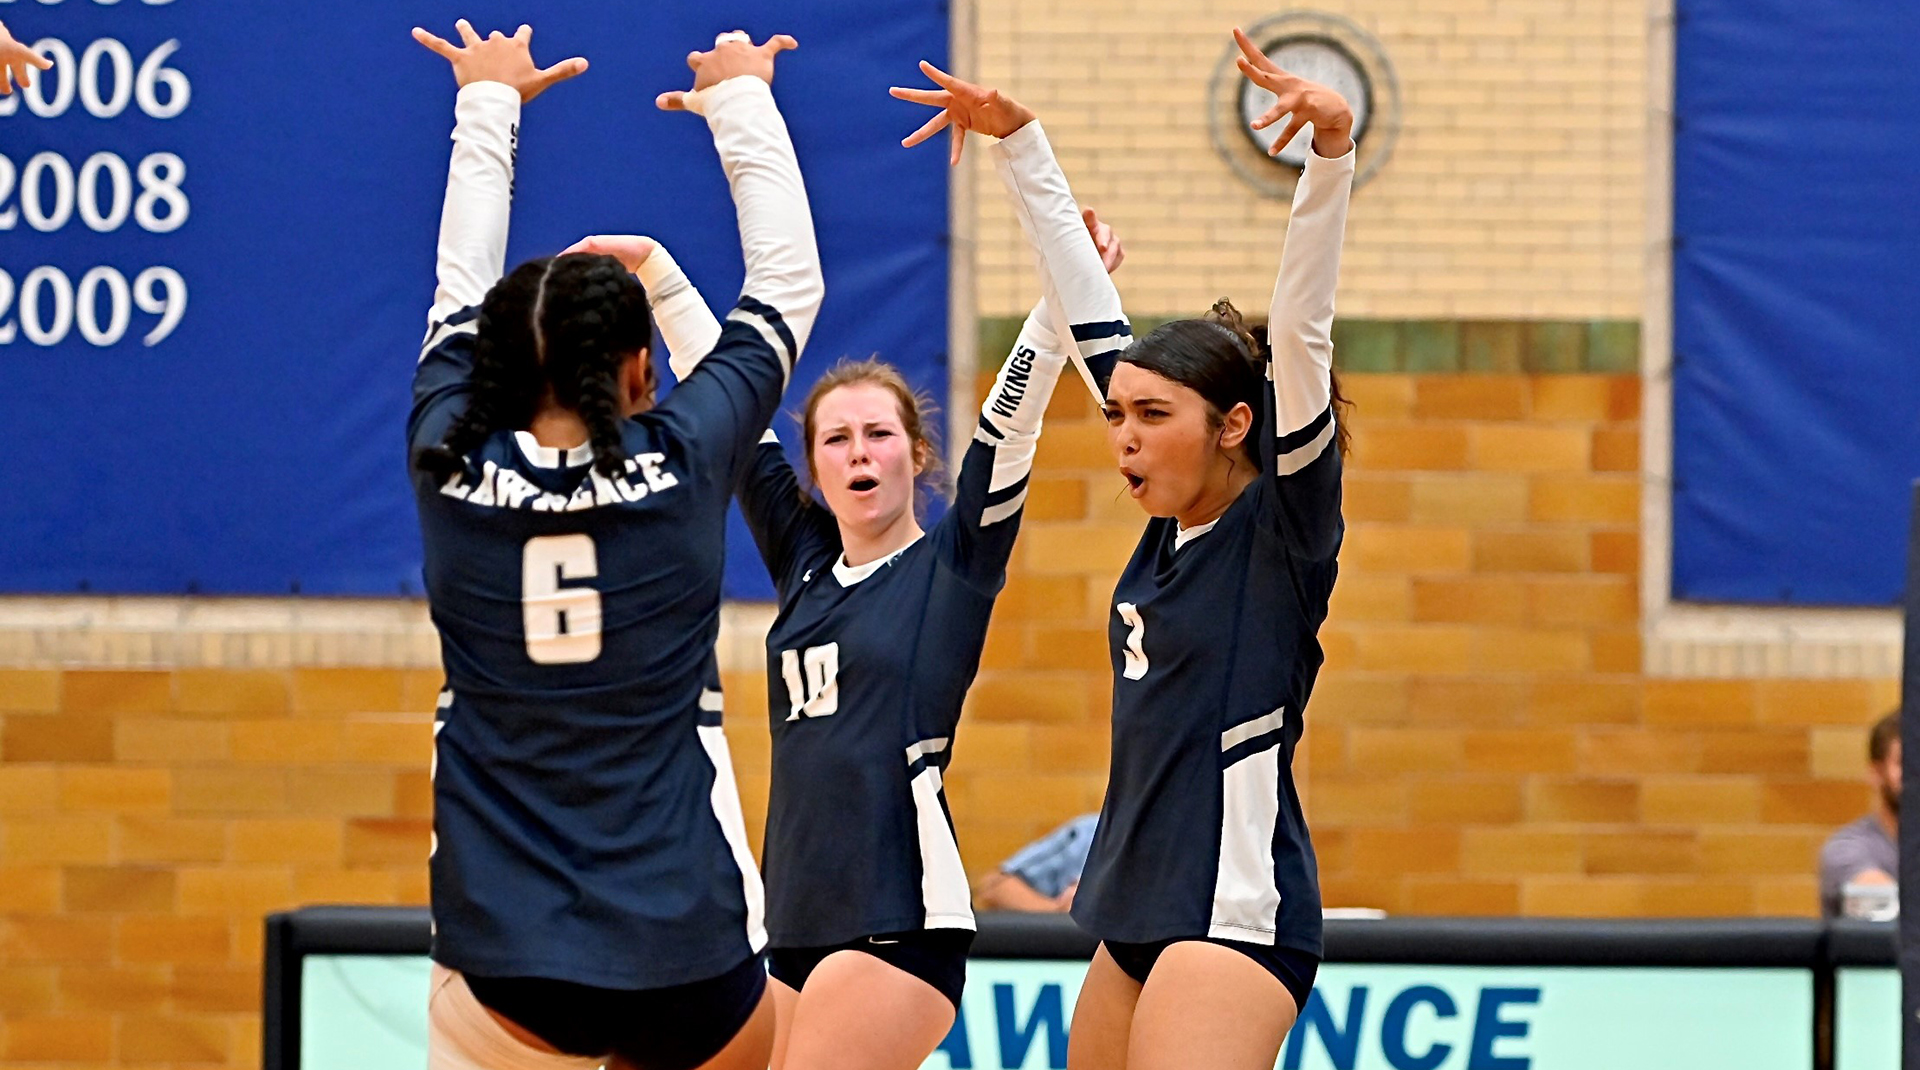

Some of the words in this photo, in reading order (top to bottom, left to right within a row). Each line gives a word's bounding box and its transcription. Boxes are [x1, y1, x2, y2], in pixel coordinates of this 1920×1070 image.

[0, 37, 192, 119] 006
[991, 345, 1036, 418] VIKINGS
[522, 533, 602, 664] 6
[781, 641, 839, 722] 10
[1116, 601, 1149, 681] 3
